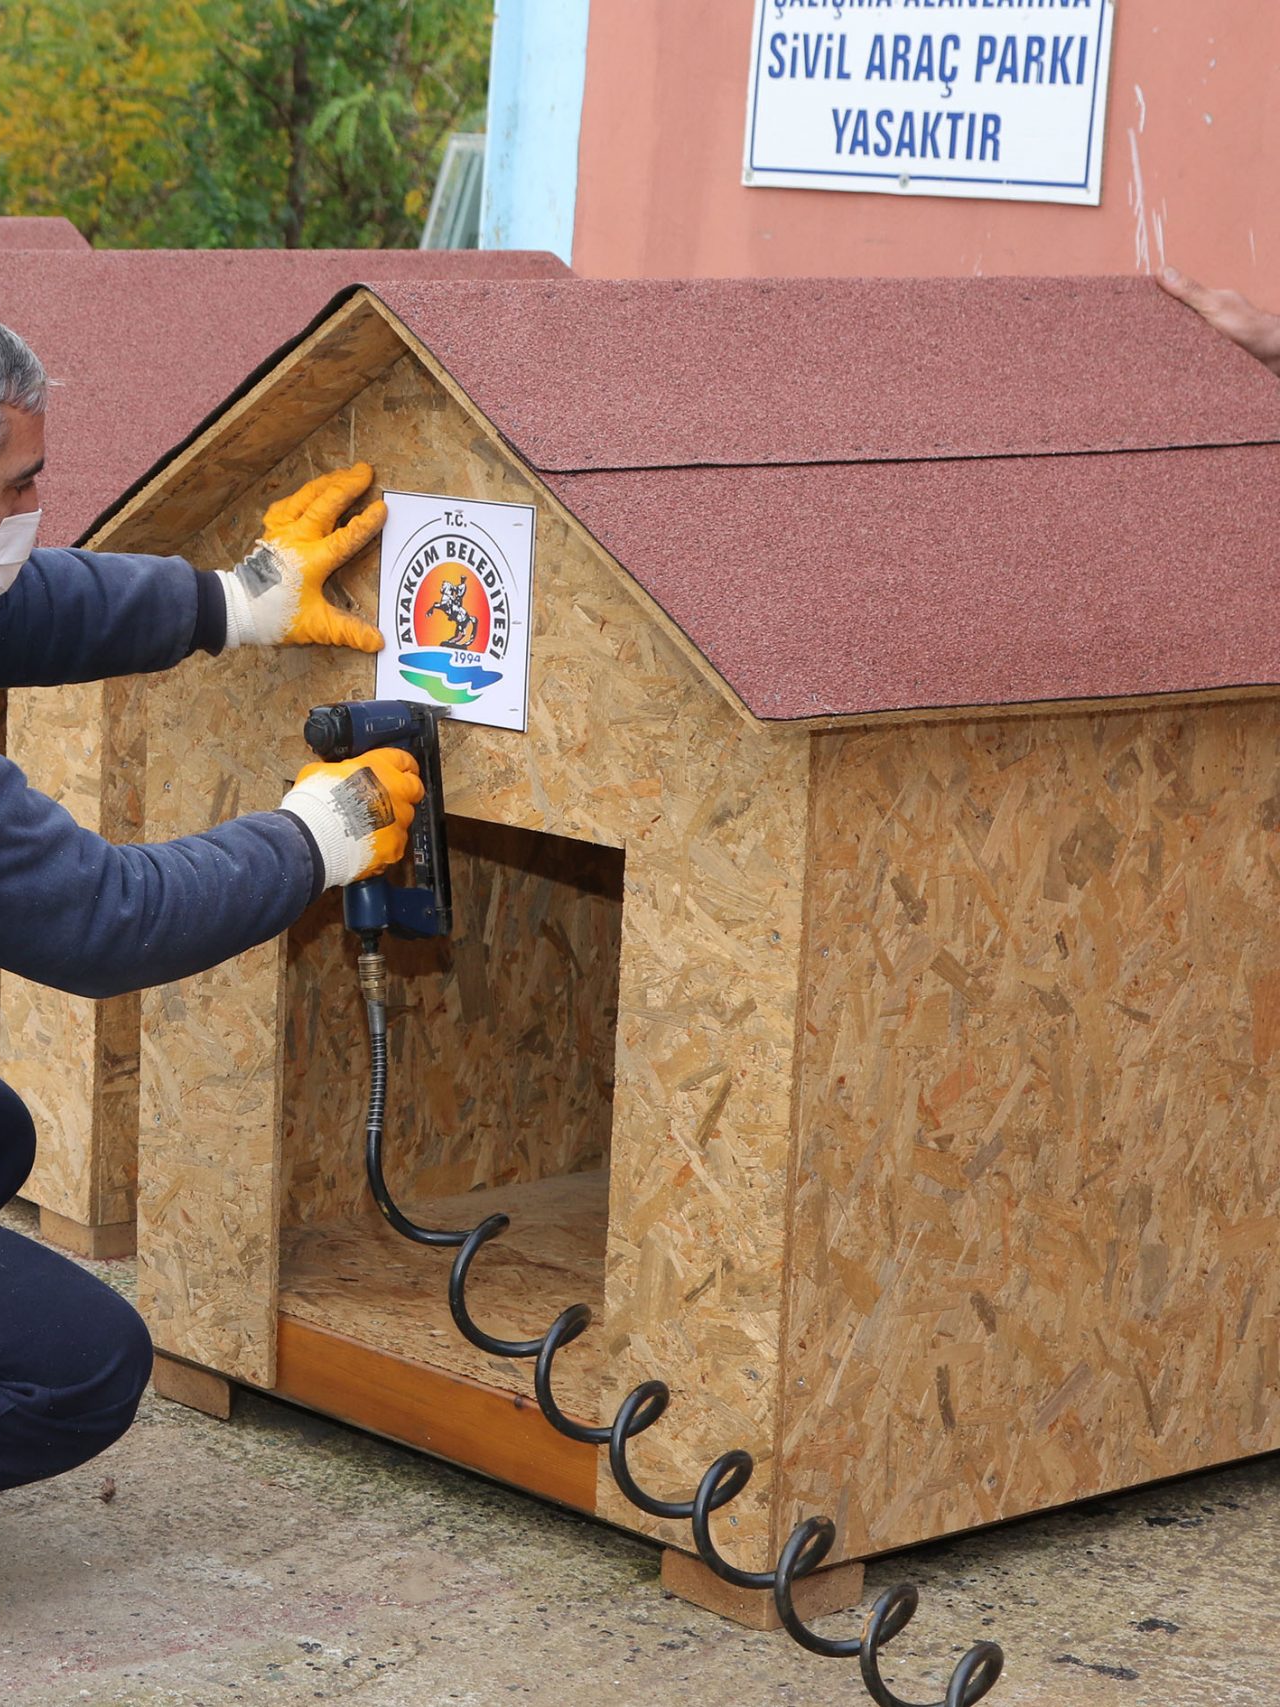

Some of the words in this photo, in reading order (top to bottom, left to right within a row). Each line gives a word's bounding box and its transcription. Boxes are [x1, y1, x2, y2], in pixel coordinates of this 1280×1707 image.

[865, 34, 960, 98] ARAÇ
[975, 35, 1088, 86] PARKI
[832, 108, 1002, 161] YASAKTIR
[444, 511, 468, 528] T.C.
[400, 546, 440, 643] ATAKUM
[454, 651, 481, 664] 1994
